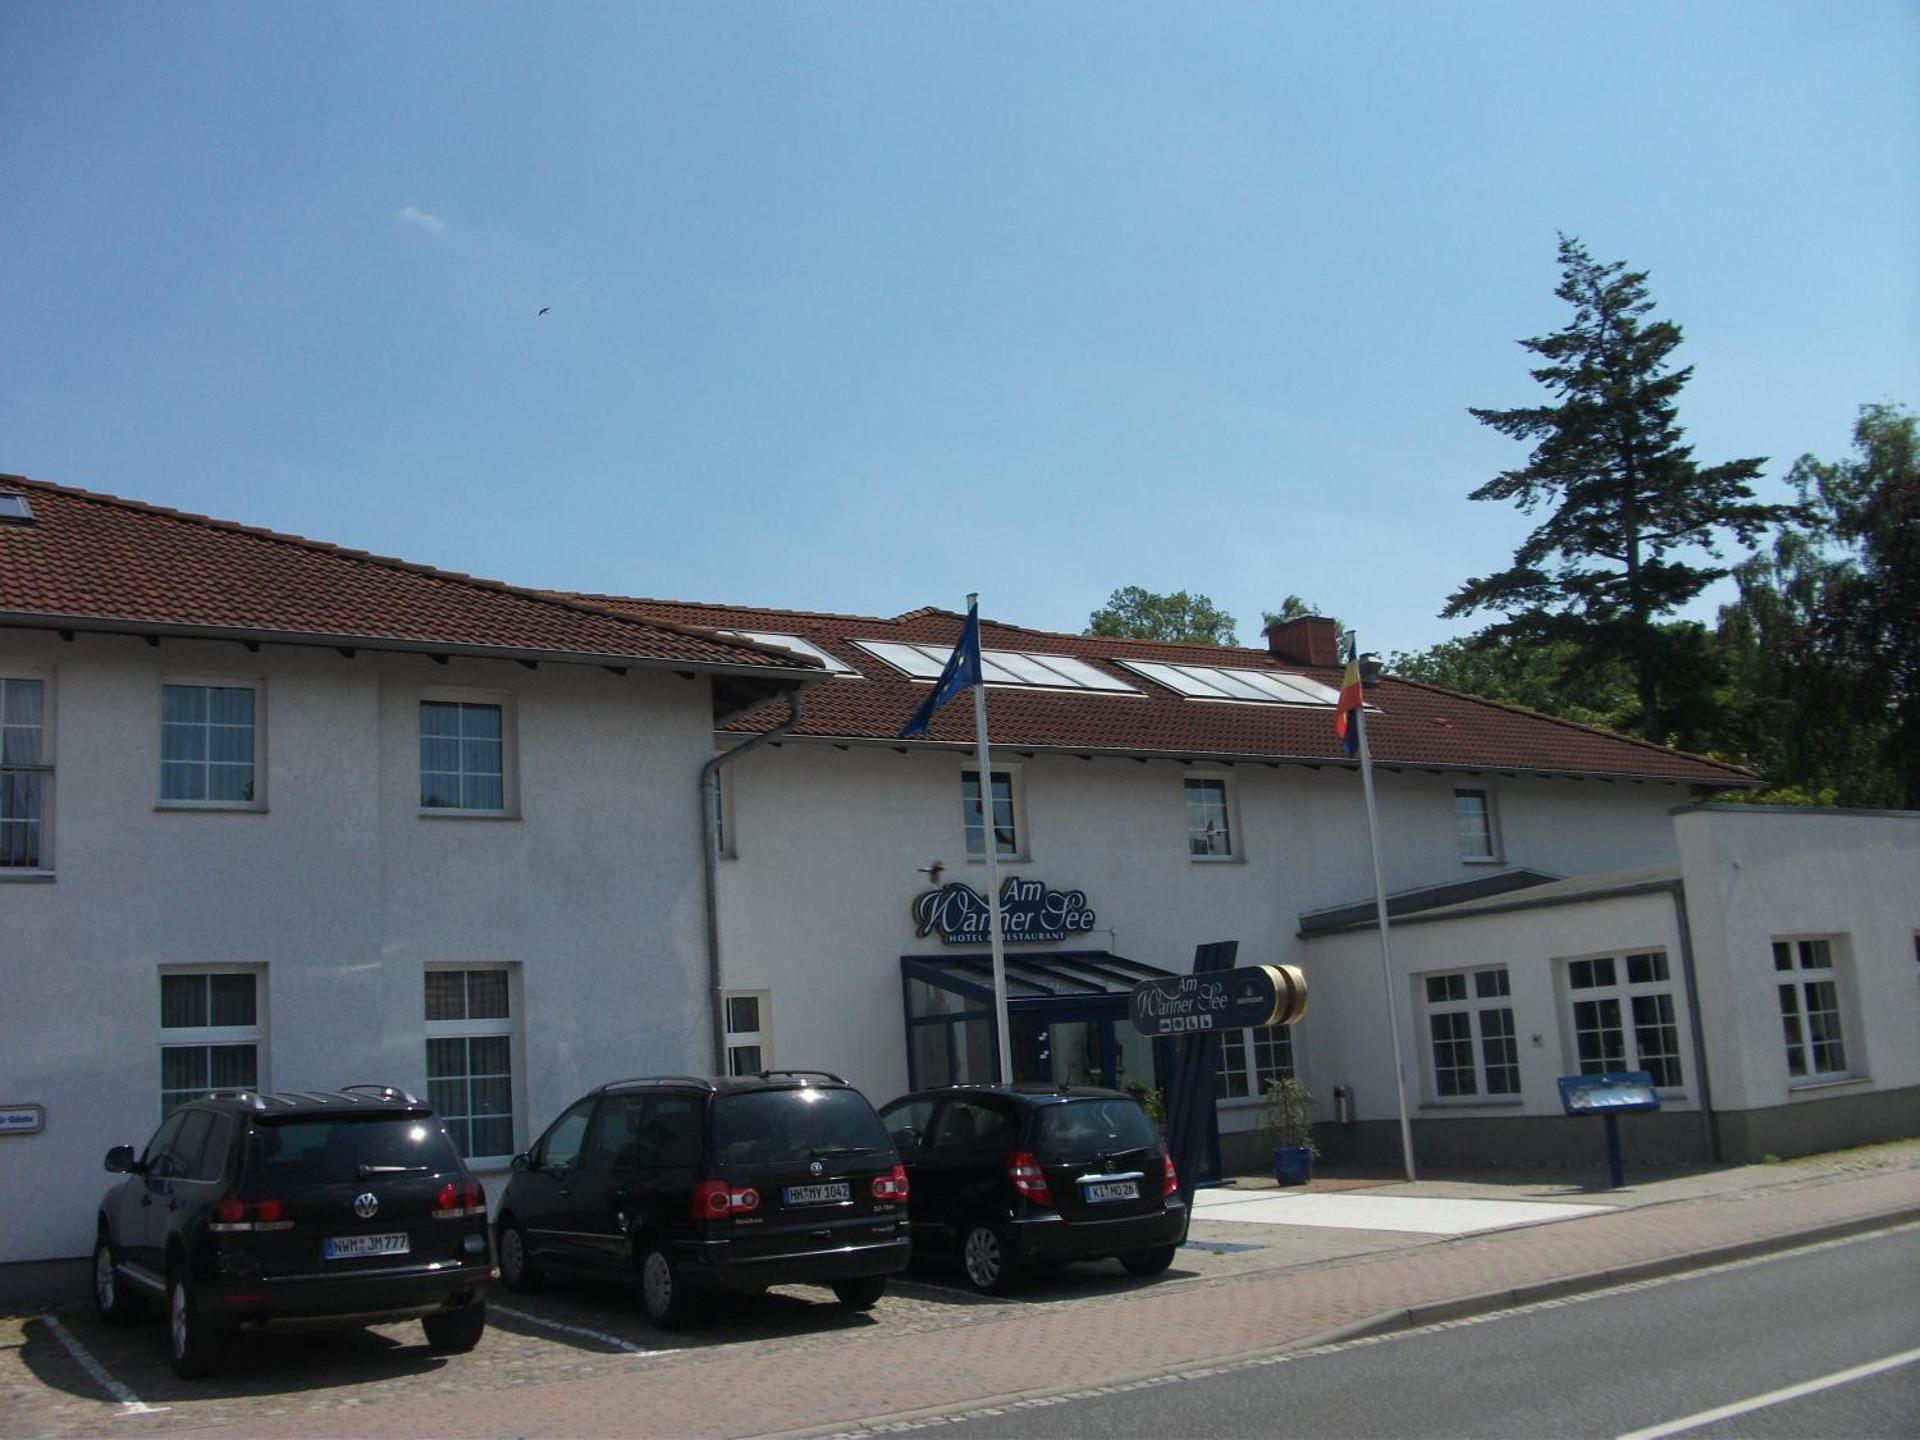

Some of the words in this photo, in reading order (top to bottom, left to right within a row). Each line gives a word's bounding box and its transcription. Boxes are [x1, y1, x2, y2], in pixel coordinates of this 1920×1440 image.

[1004, 879, 1042, 901] Am
[919, 884, 1035, 933] Warner
[1040, 892, 1094, 931] See
[949, 934, 983, 942] HOTEL
[1179, 978, 1198, 993] Am
[1198, 982, 1228, 1011] See
[824, 1185, 848, 1198] 1042
[334, 1239, 358, 1254] NWM
[385, 1235, 406, 1250] 777
